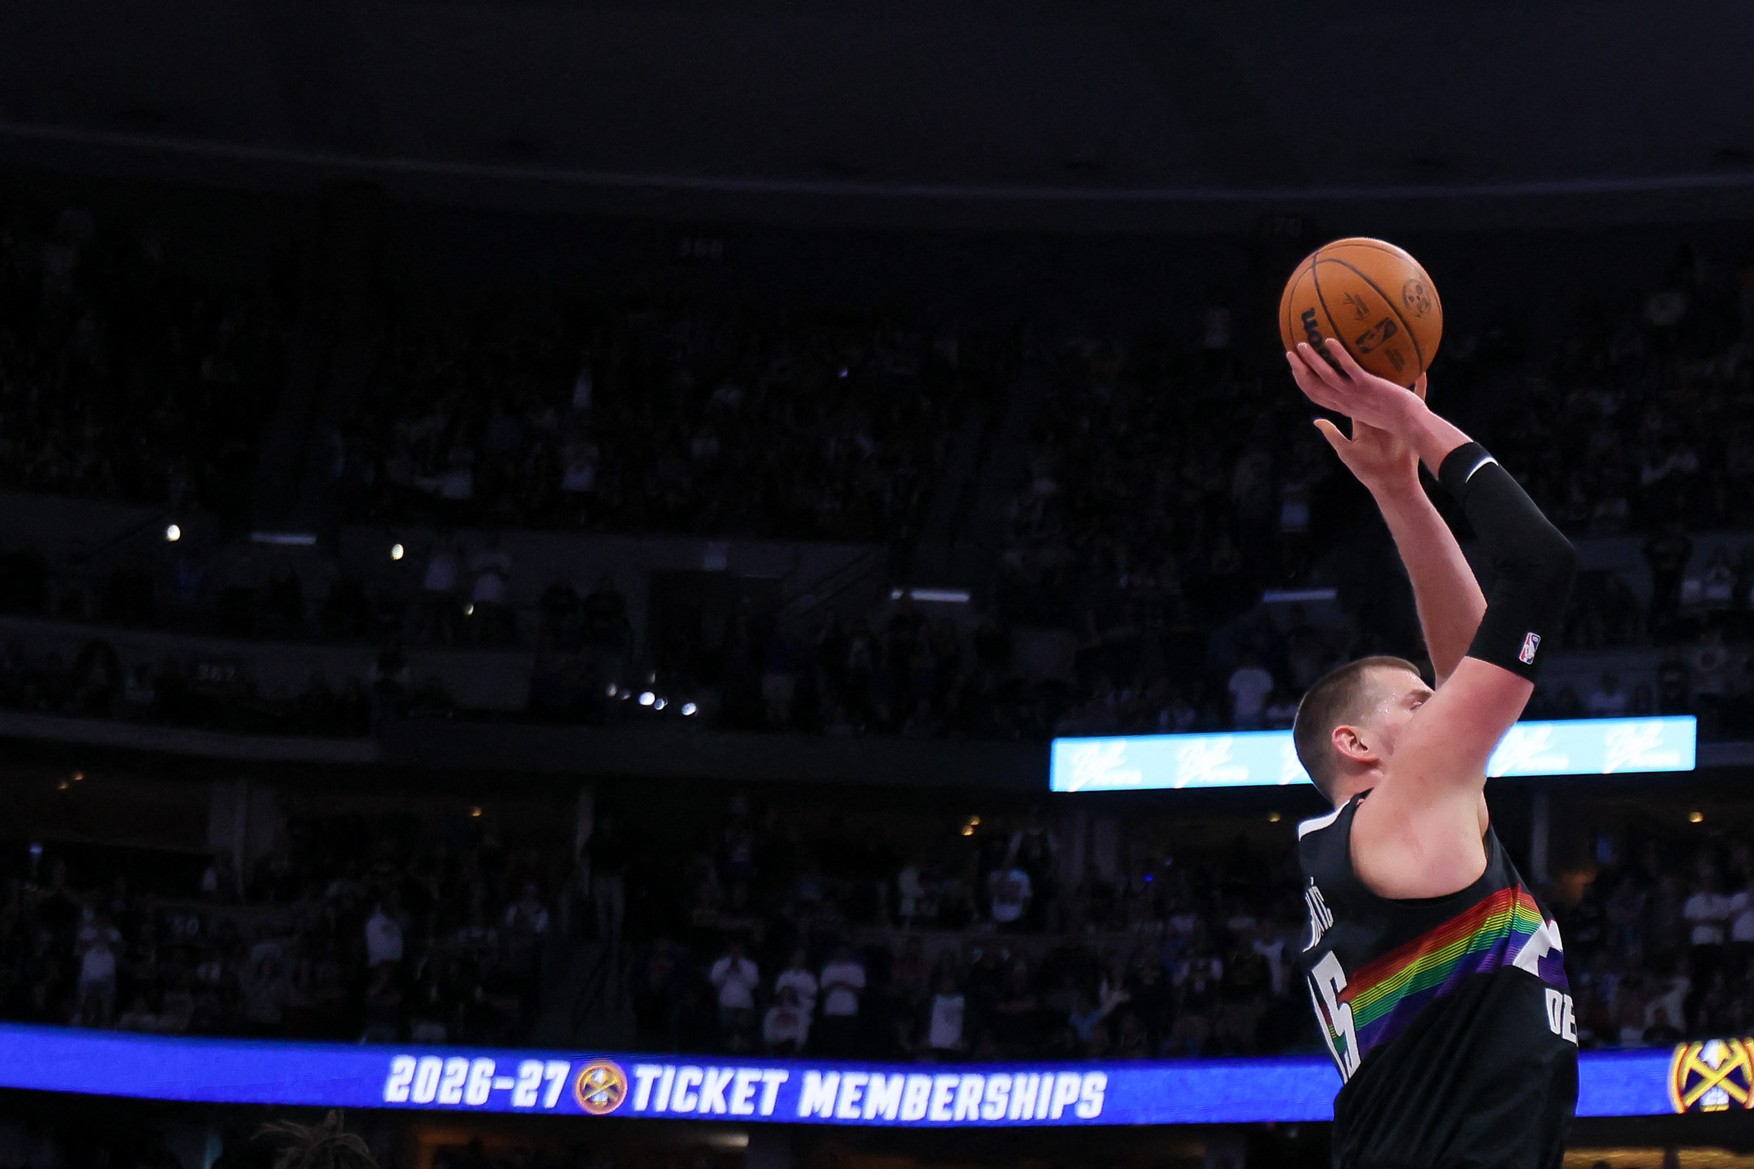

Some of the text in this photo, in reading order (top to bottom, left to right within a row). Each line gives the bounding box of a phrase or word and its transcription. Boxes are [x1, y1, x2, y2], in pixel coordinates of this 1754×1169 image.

[384, 1054, 1108, 1122] 2026-27 TICKET MEMBERSHIPS
